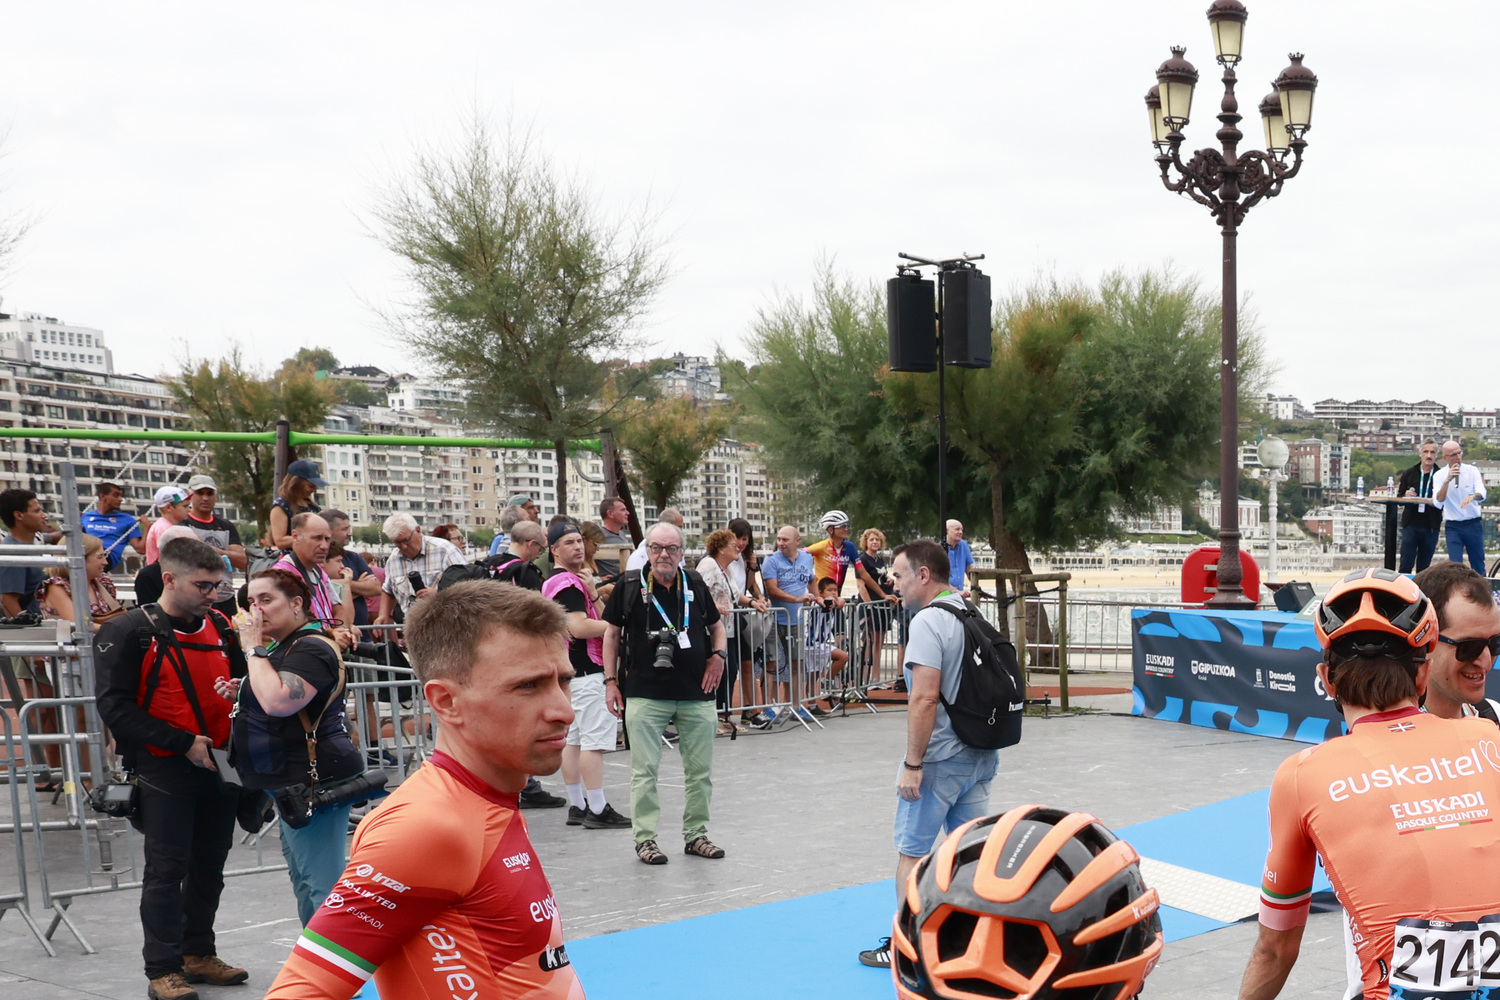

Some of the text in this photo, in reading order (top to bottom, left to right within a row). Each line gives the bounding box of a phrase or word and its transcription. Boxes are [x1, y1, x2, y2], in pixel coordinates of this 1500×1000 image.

[1145, 653, 1175, 667] EUSKADI
[1198, 662, 1236, 678] GIPUZKOA
[1268, 670, 1296, 682] Donostia
[1328, 747, 1483, 802] euskaltel
[1389, 791, 1485, 819] EUSKADI
[1395, 808, 1489, 830] BASQUE COUNTRY
[346, 906, 385, 930] EUSKADI
[1393, 934, 1480, 987] 214
